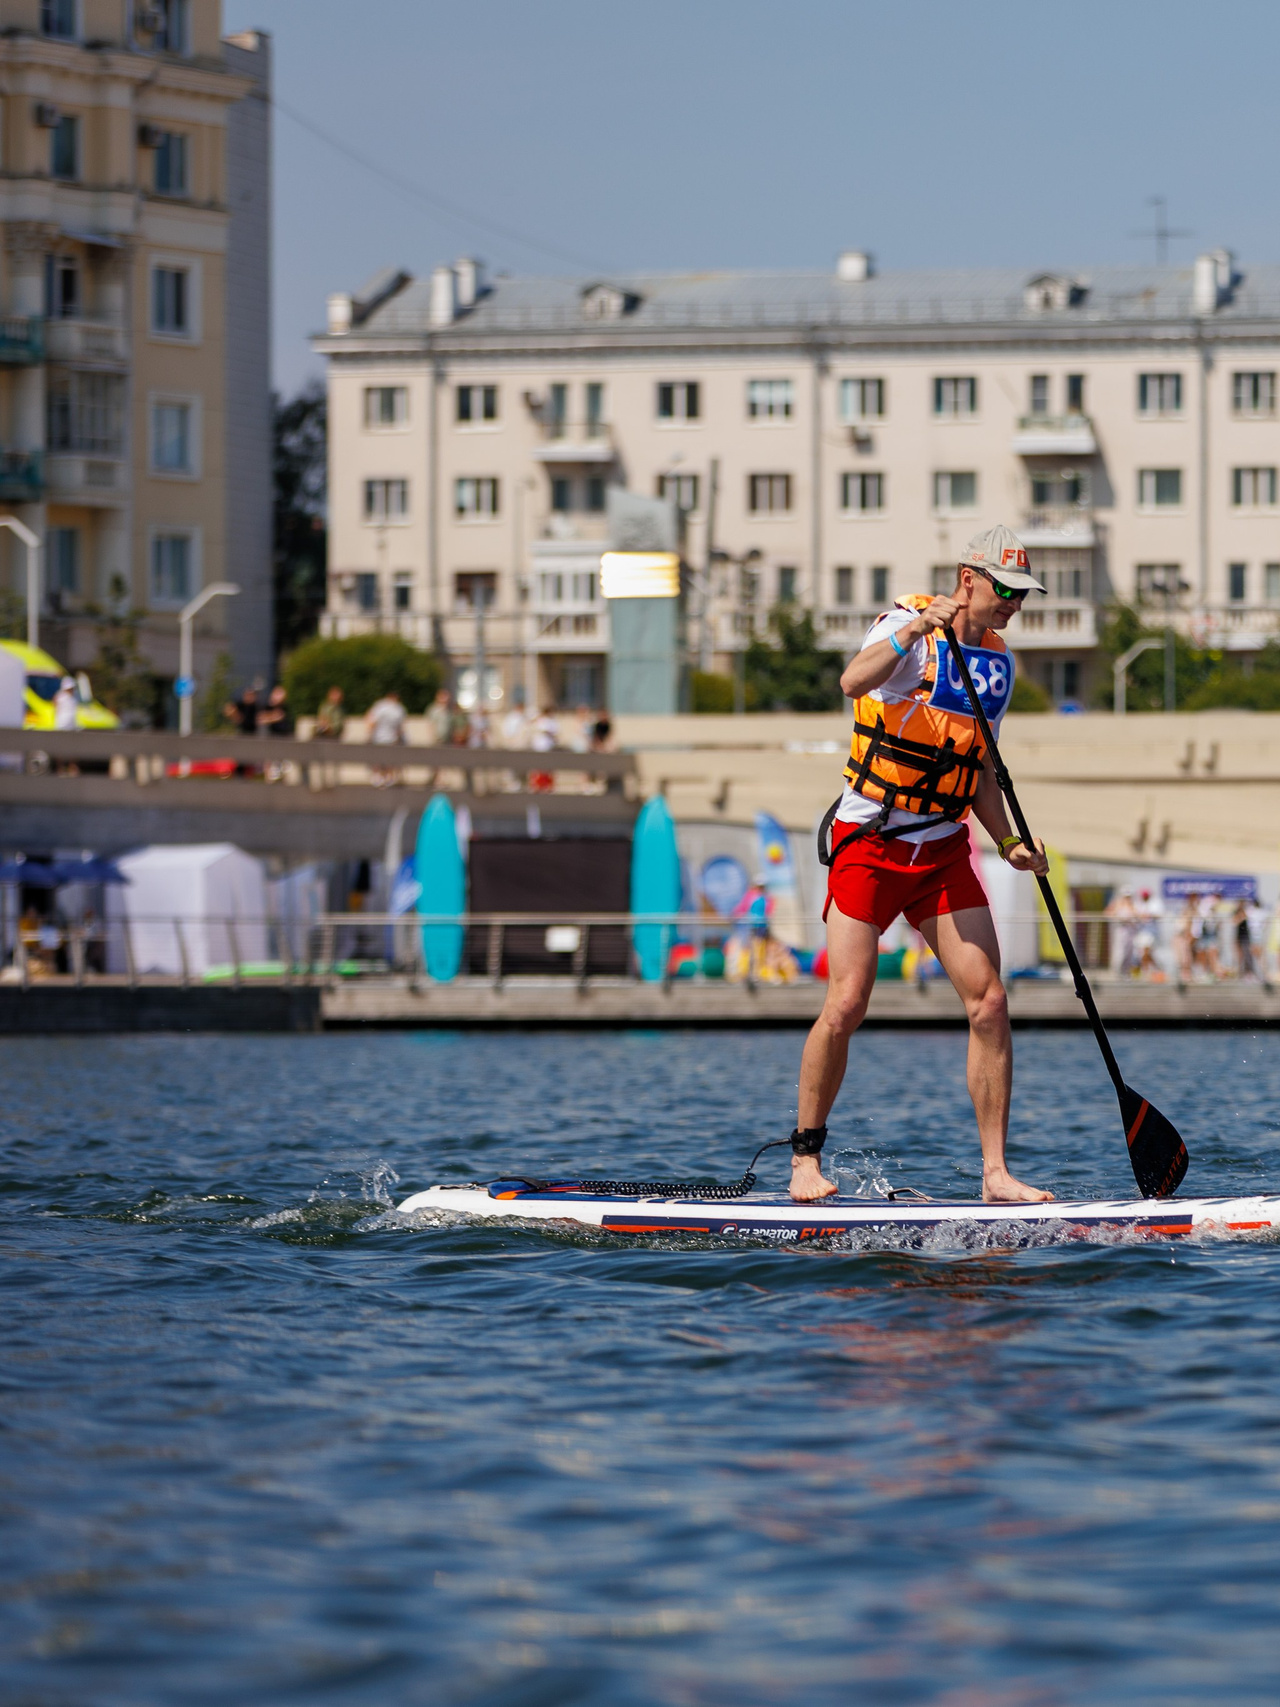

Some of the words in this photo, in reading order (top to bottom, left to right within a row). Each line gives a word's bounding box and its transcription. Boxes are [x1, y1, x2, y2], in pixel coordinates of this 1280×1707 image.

[1001, 548, 1030, 568] FO
[946, 649, 1008, 698] 068
[1160, 1151, 1181, 1195] ELITE
